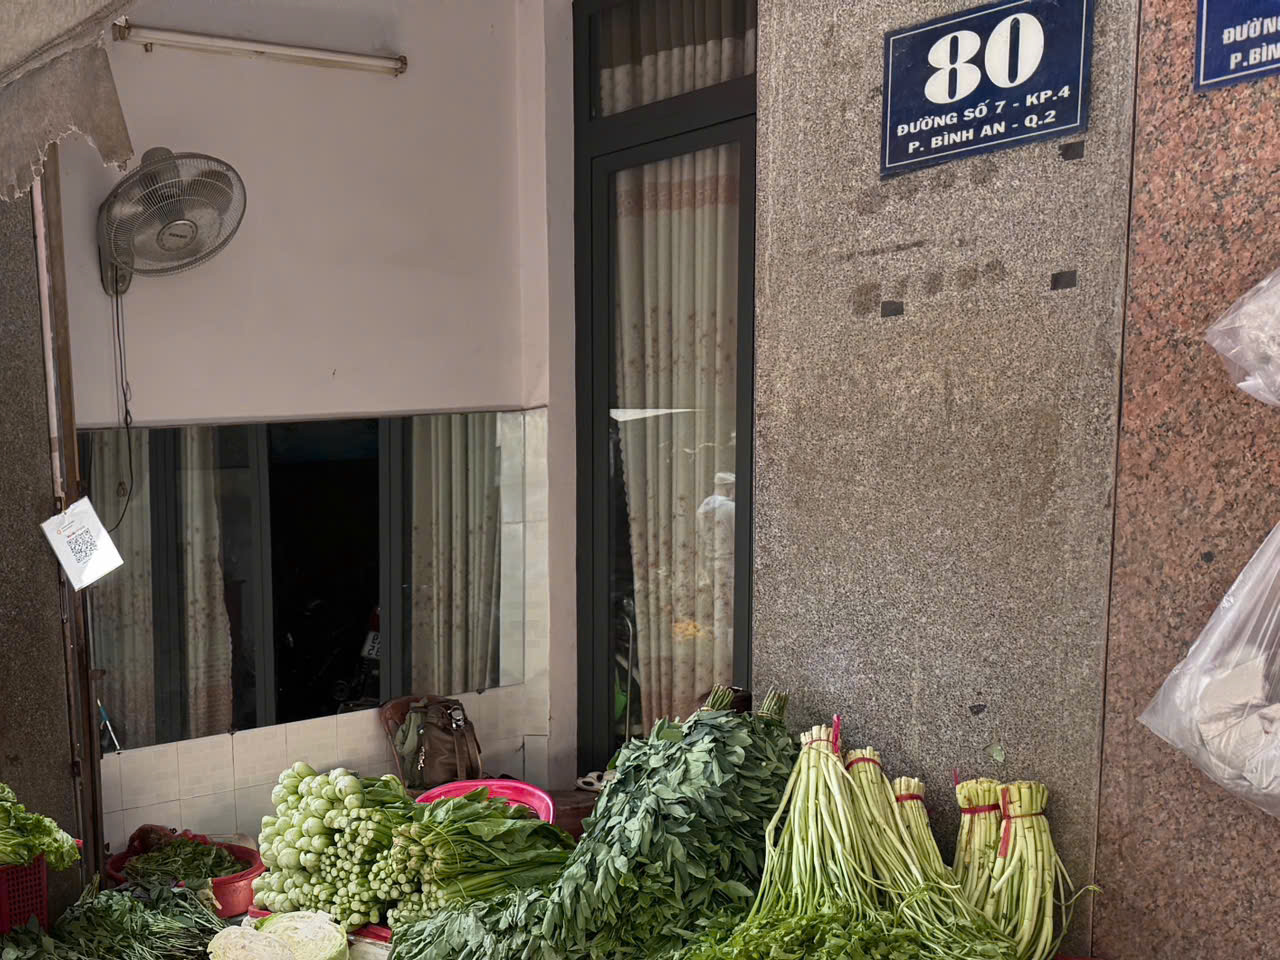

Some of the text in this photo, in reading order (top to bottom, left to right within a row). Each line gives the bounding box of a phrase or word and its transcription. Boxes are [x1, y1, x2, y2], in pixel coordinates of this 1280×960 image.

[1222, 16, 1280, 45] ĐƯỜN
[924, 13, 1045, 105] 80
[897, 112, 958, 136] ĐƯỜNG
[963, 99, 990, 121] SỐ
[995, 100, 1006, 114] 7
[1026, 85, 1070, 107] KP.4
[908, 141, 924, 153] P.
[931, 129, 974, 149] BÌNH
[980, 121, 1006, 138] AN
[1024, 110, 1056, 128] Q.2
